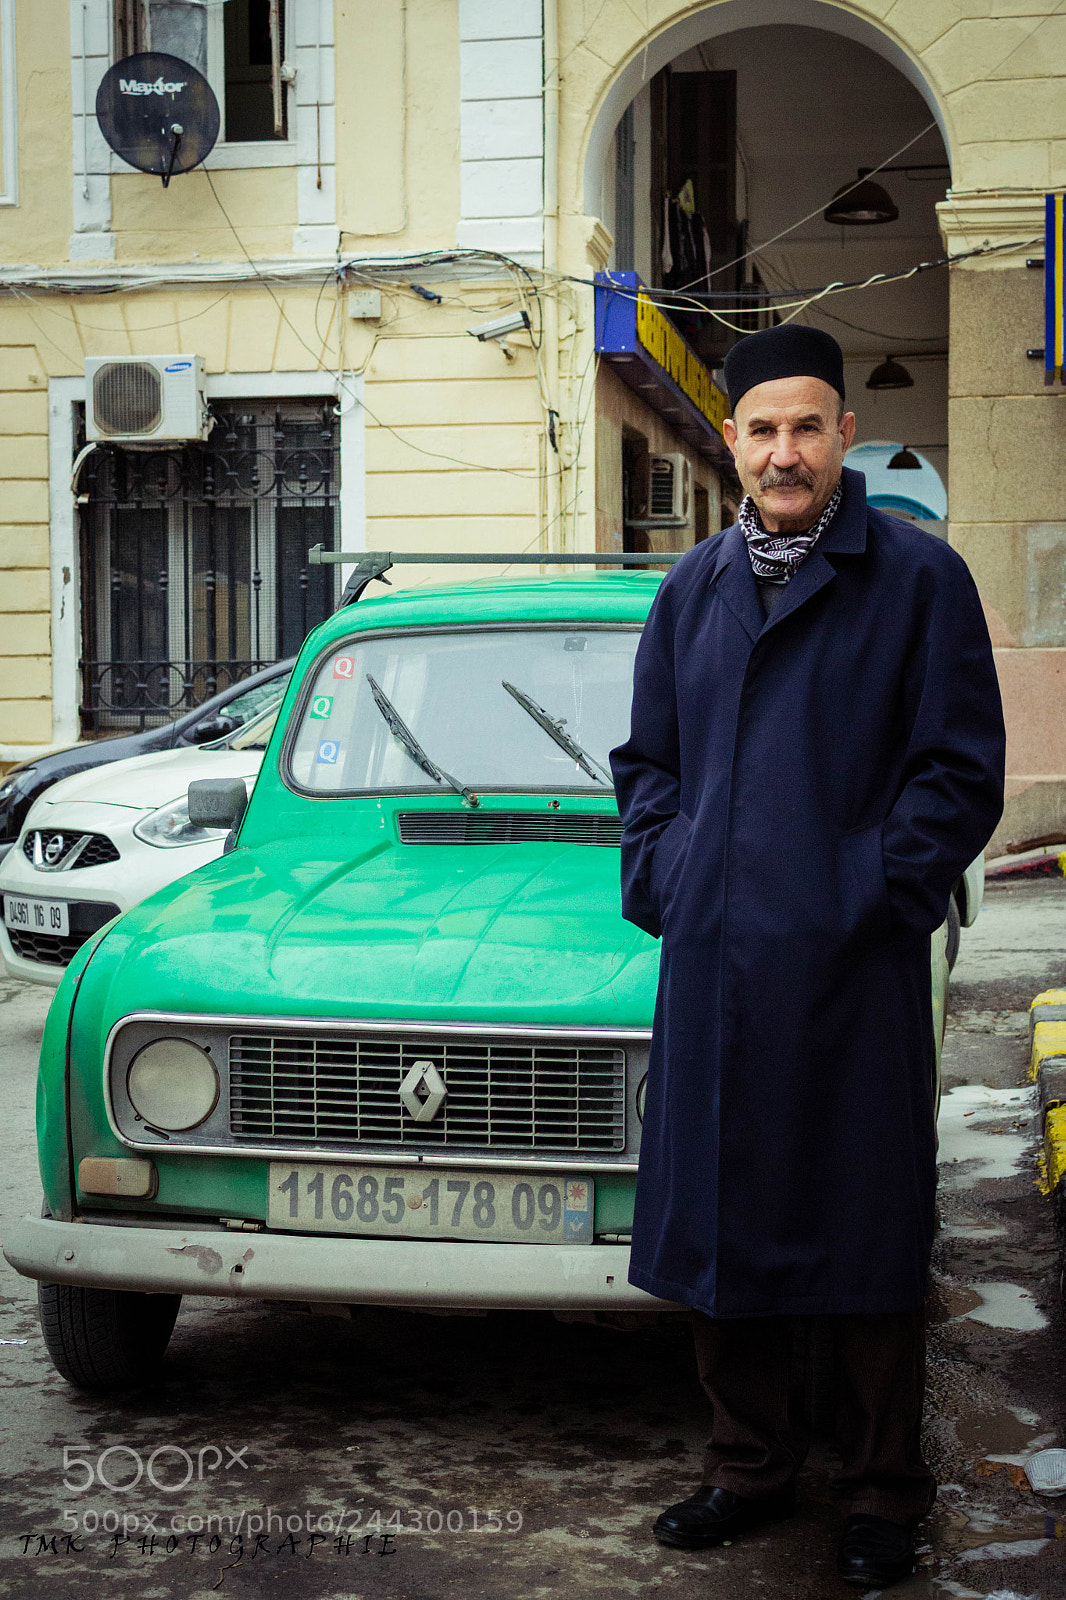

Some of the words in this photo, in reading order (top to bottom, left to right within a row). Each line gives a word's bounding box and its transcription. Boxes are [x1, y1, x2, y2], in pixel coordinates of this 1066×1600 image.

[119, 77, 184, 95] Maxtor
[335, 658, 352, 677] Q
[313, 697, 330, 718] Q
[319, 742, 336, 762] Q
[50, 906, 61, 928] 09
[281, 1171, 405, 1224] 11685
[422, 1179, 496, 1228] 178
[512, 1183, 561, 1231] 09
